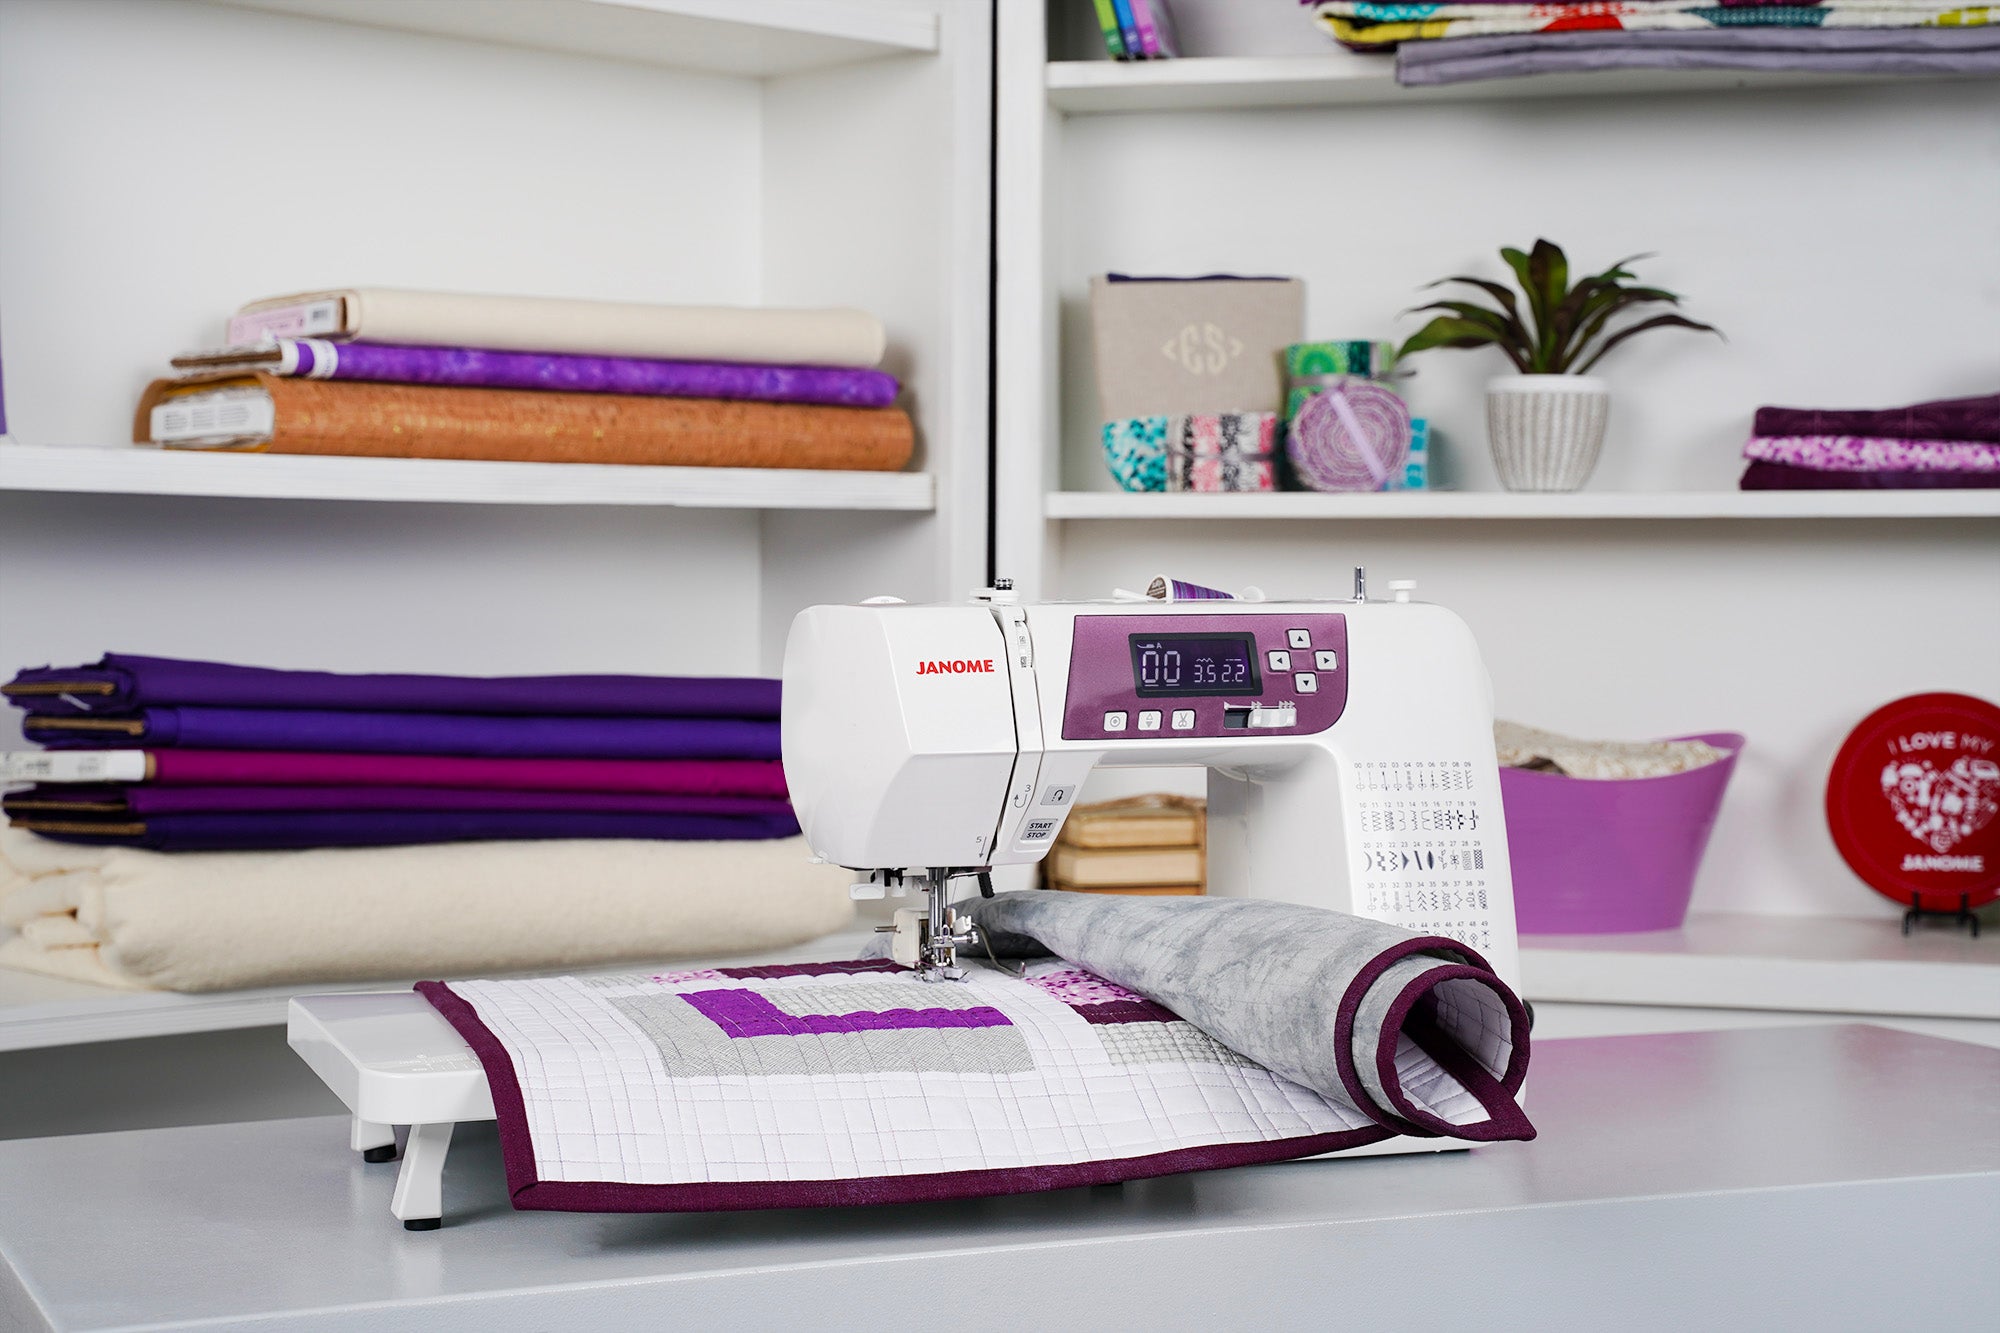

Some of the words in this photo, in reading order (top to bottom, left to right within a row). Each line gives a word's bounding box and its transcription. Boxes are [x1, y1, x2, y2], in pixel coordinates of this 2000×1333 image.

[916, 659, 995, 675] JANOME
[1142, 651, 1180, 684] 00
[1194, 664, 1217, 683] 3.5
[1221, 663, 1245, 682] 2.2
[1899, 731, 1956, 752] LOVE
[1960, 734, 1995, 754] MY
[1024, 784, 1032, 792] 3
[1901, 855, 1984, 872] JANOME
